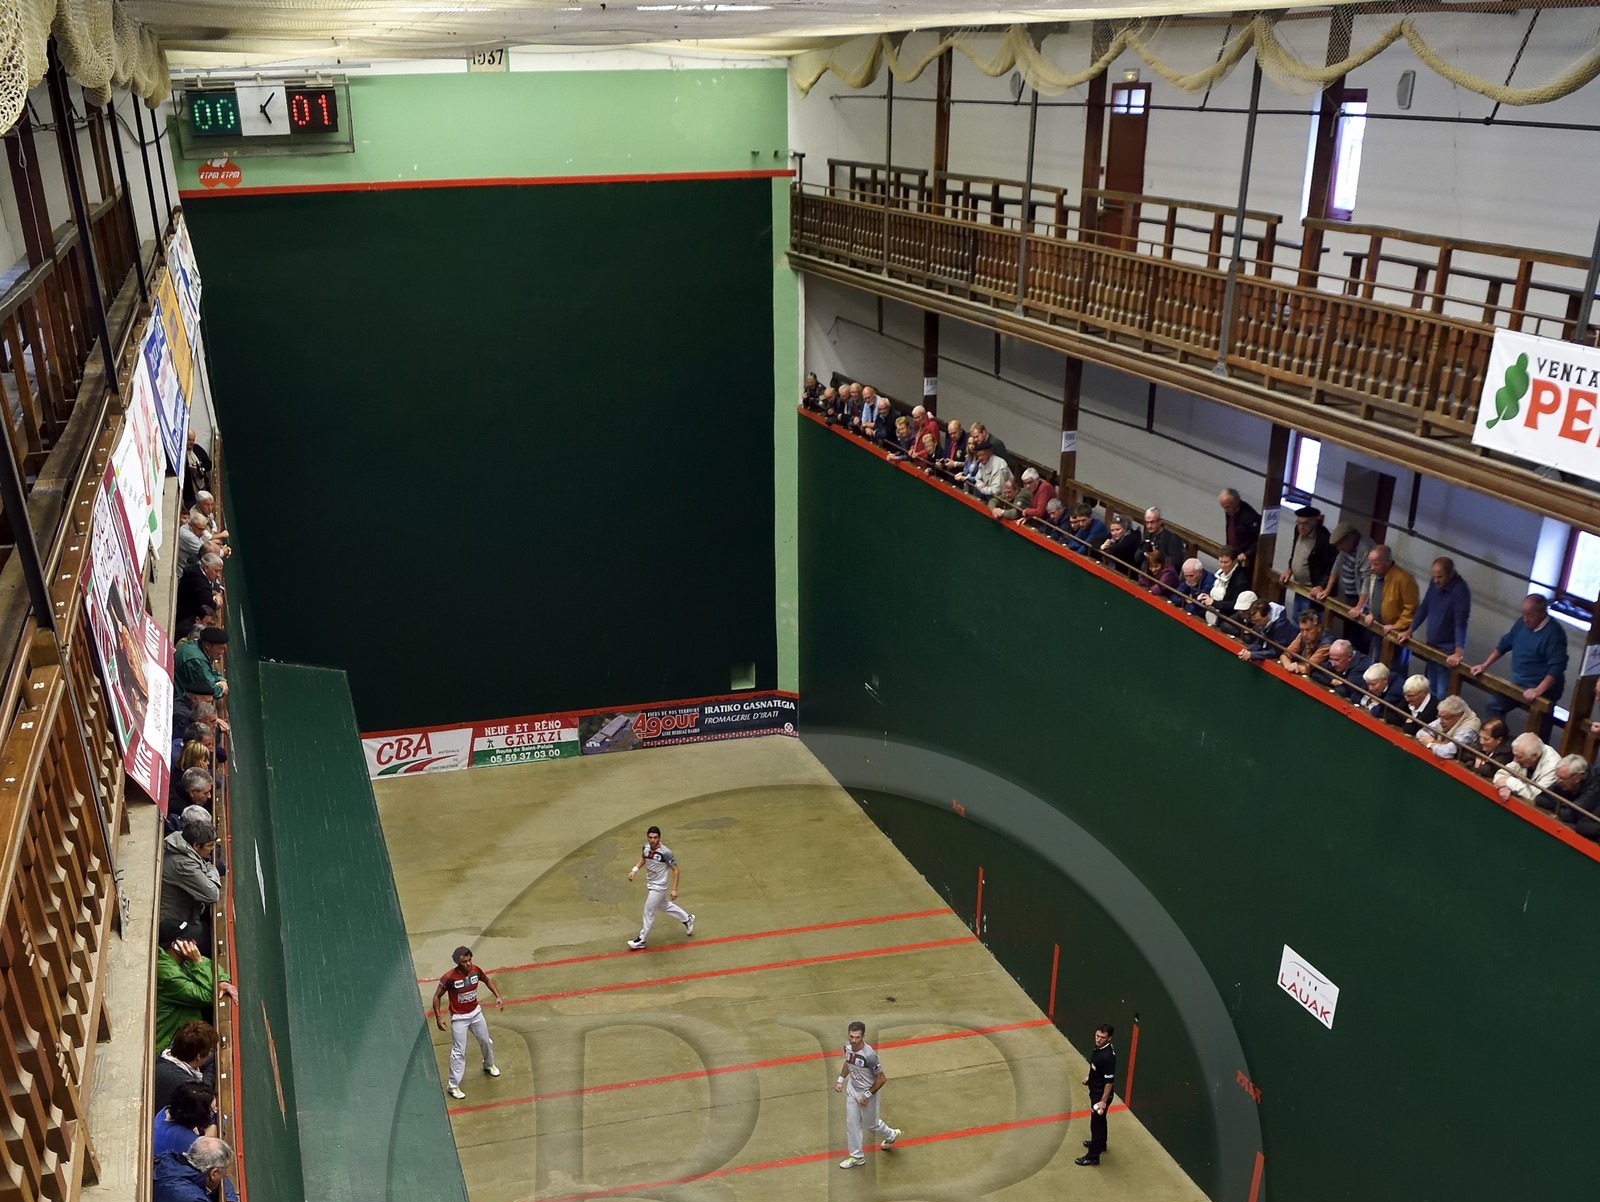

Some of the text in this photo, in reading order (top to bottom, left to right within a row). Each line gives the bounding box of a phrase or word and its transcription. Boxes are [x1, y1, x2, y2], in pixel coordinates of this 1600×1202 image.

[292, 94, 331, 126] 01
[1537, 356, 1600, 389] VENTA
[1523, 377, 1600, 449] PE
[704, 699, 796, 715] IRATIKO GASNATEGIA
[704, 710, 779, 725] FROMAGERIE D'IRATI
[484, 720, 562, 736] NEUF ET RÉNO
[505, 730, 562, 746] GARAZI
[631, 712, 700, 739] Agour
[376, 732, 432, 766] CBA
[490, 748, 560, 763] 05 59 37 03 00
[1280, 972, 1332, 1025] LAUAK
